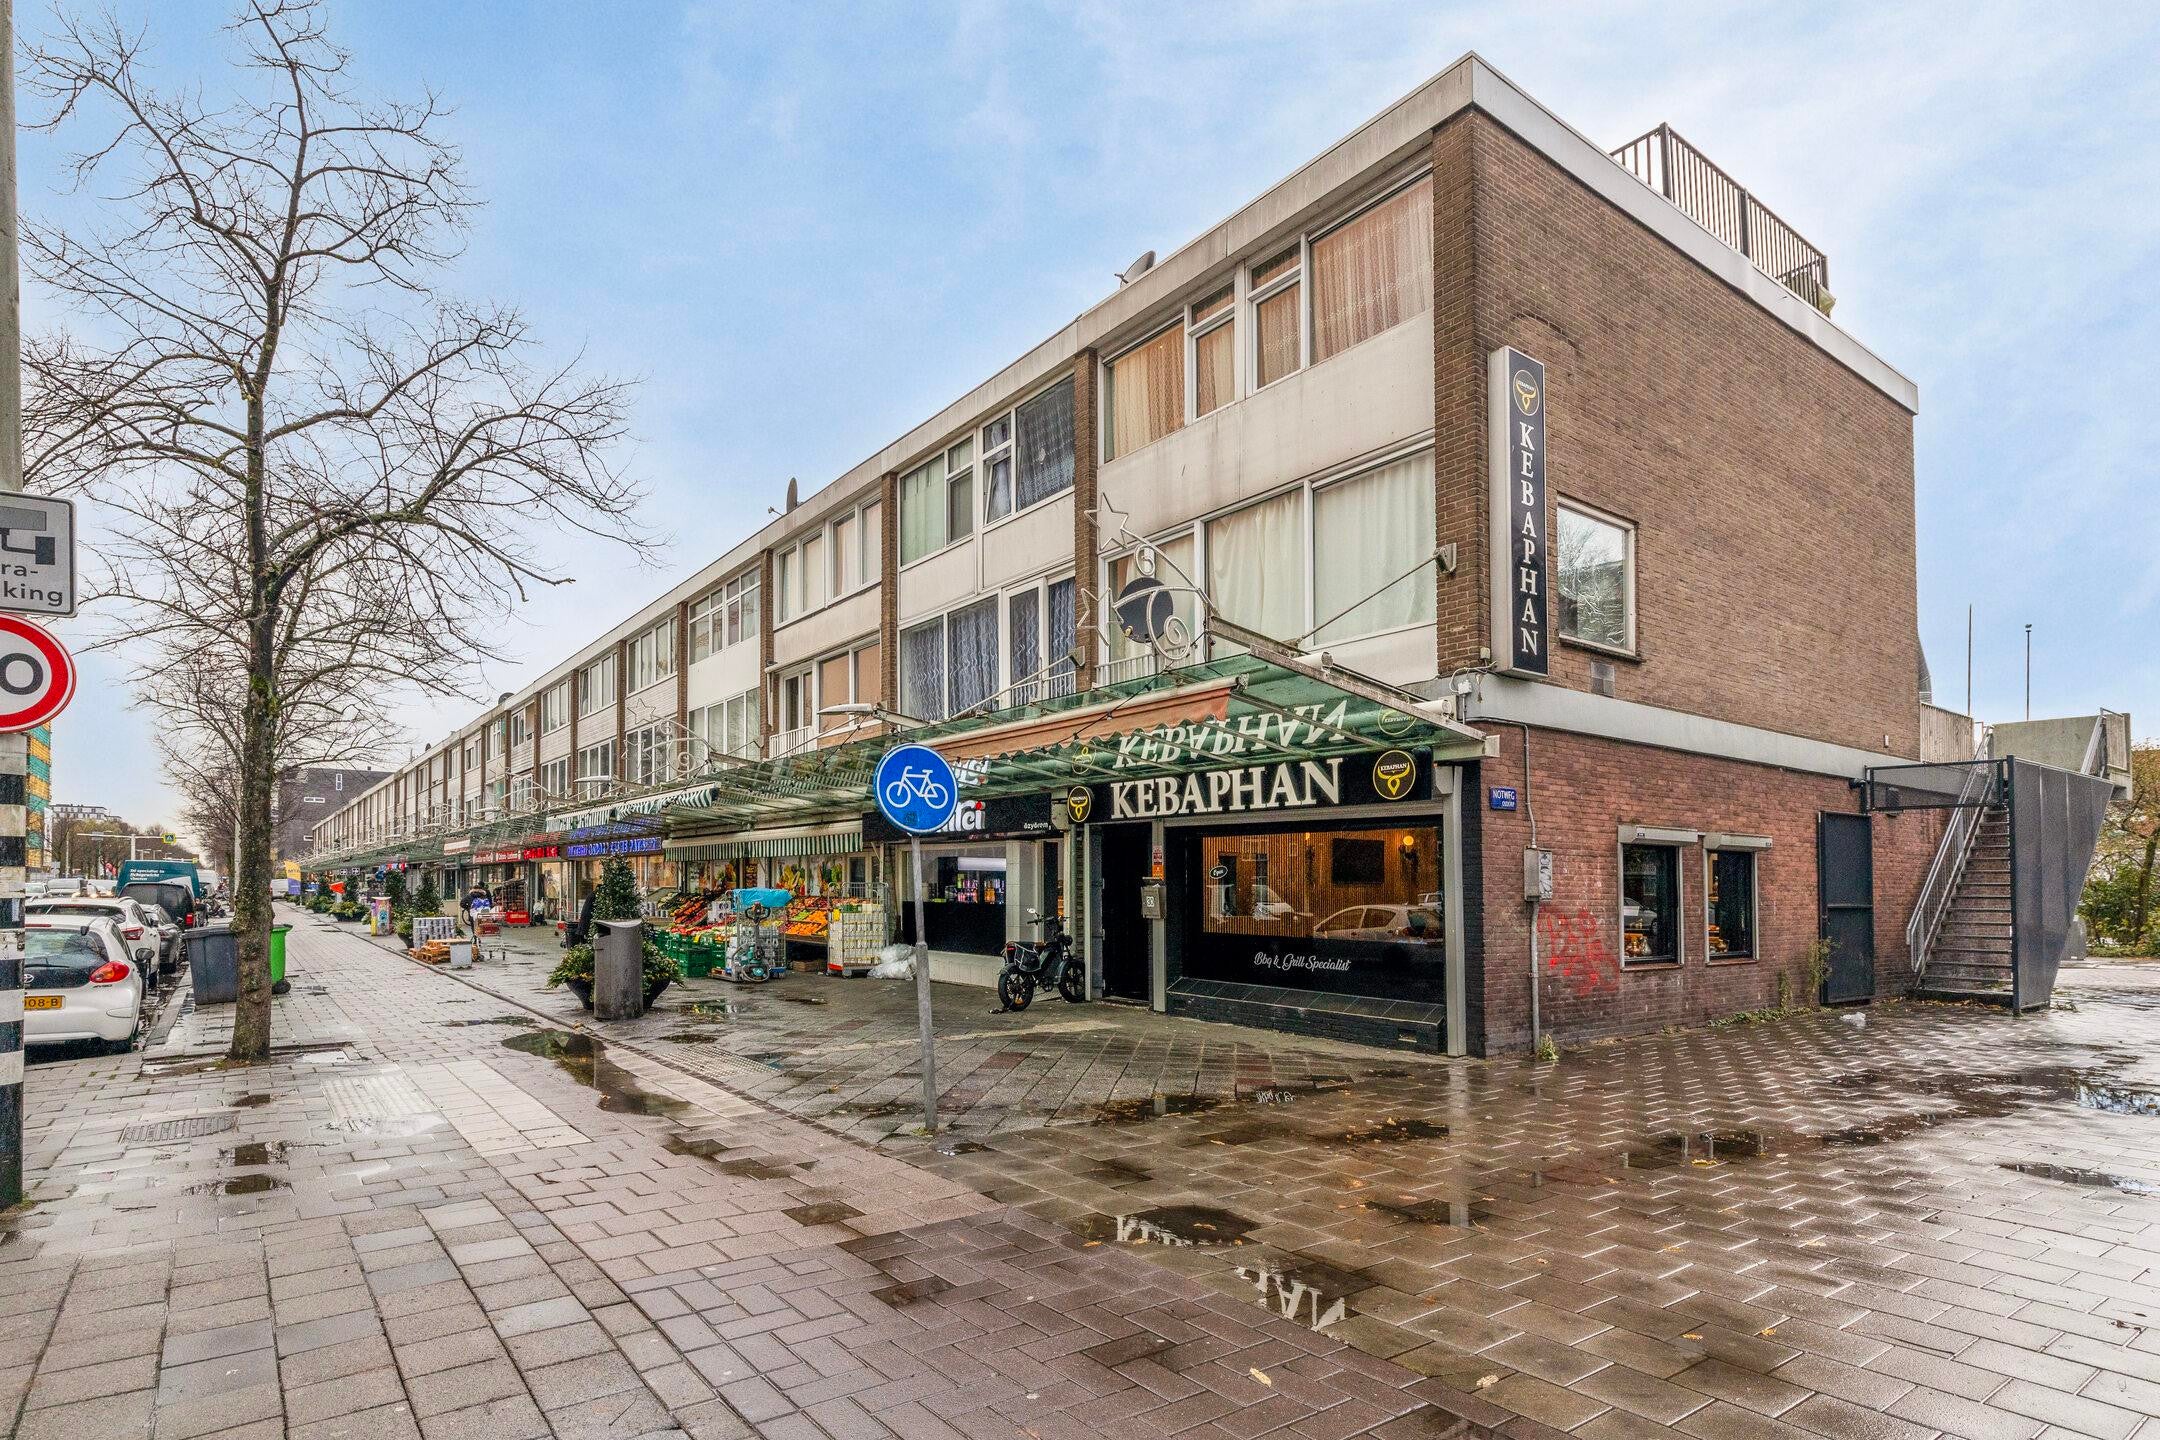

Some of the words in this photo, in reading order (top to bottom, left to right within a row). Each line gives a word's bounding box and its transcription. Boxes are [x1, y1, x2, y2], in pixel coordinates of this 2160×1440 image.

[1519, 421, 1538, 656] KEBAPHAN
[1, 563, 38, 577] ra-
[3, 581, 63, 607] king
[1111, 757, 1344, 819] KEBAPHAN
[1254, 951, 1273, 968] Bbq
[1281, 953, 1306, 971] Grill
[1305, 955, 1352, 972] Specialist
